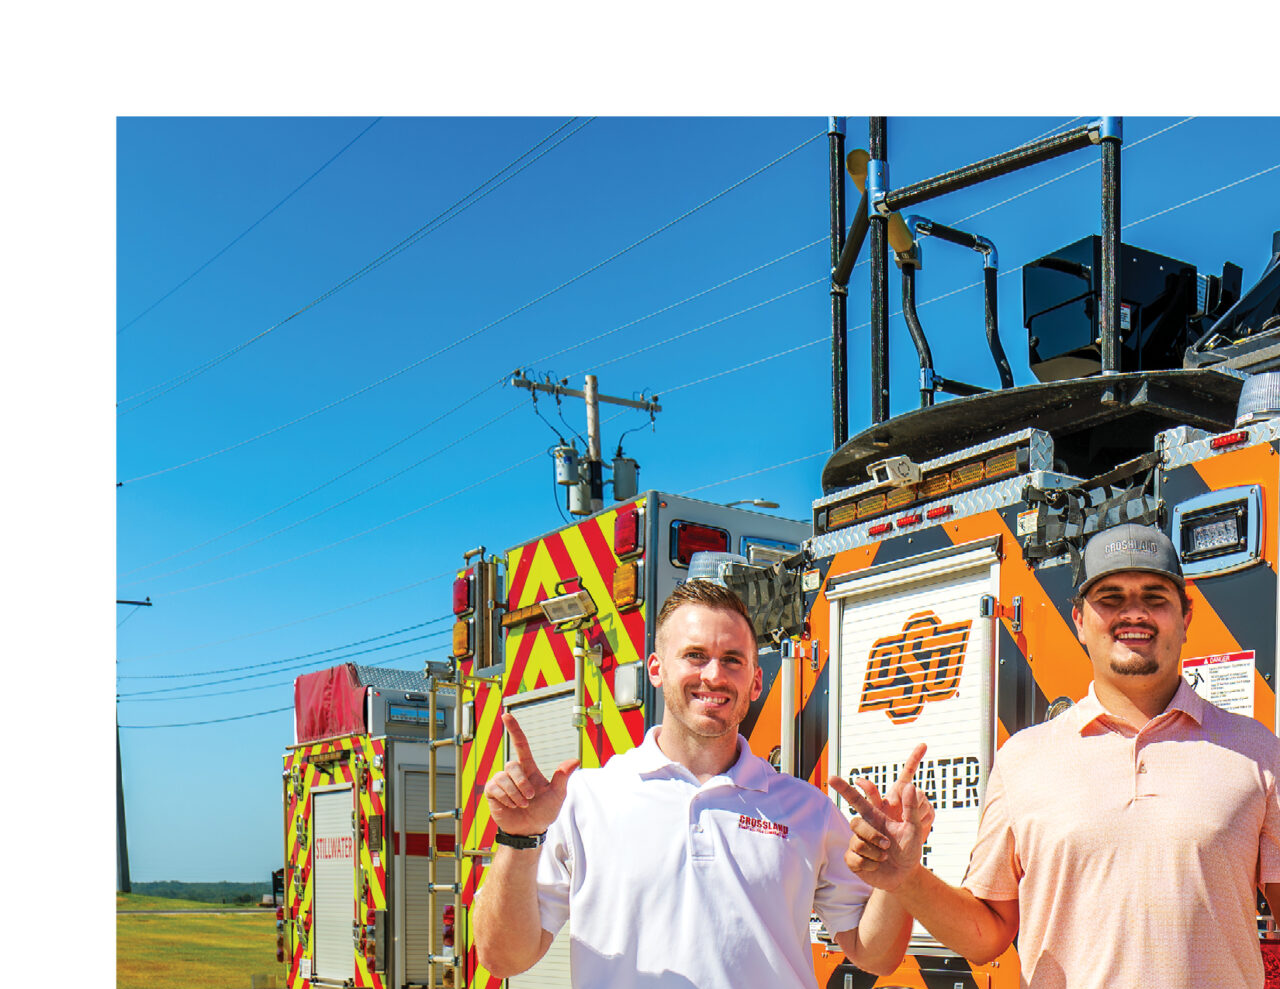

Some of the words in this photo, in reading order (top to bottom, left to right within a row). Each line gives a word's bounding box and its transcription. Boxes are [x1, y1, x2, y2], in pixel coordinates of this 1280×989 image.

[1209, 655, 1231, 664] DANGER
[739, 814, 789, 835] CROSSLAND
[315, 836, 353, 860] STILLWATER
